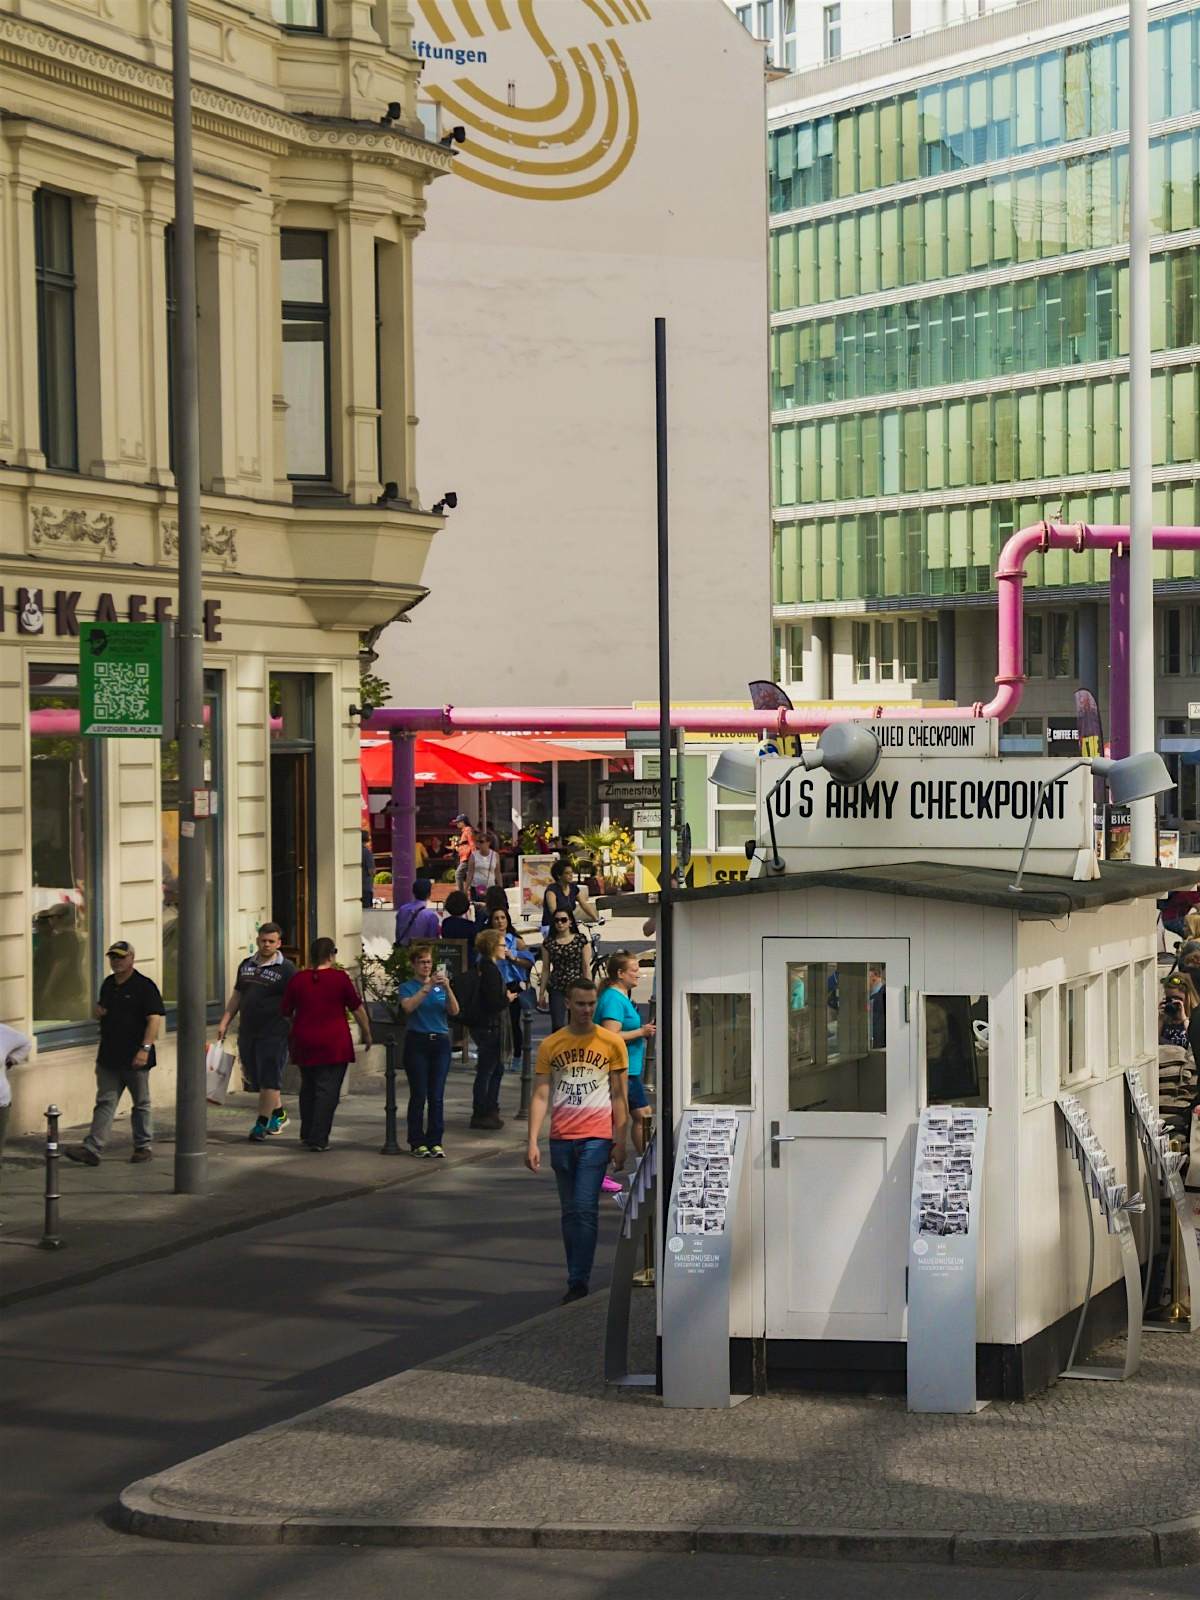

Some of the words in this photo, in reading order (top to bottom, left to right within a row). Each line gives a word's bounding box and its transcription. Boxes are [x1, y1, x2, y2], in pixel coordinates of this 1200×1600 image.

[55, 590, 222, 642] KAFFE
[908, 725, 976, 747] CHECKPOINT
[775, 780, 791, 818] U
[799, 779, 814, 818] S
[825, 780, 900, 820] ARMY
[909, 780, 1069, 820] CHECKPOINT
[551, 1047, 610, 1072] SUPERDRY
